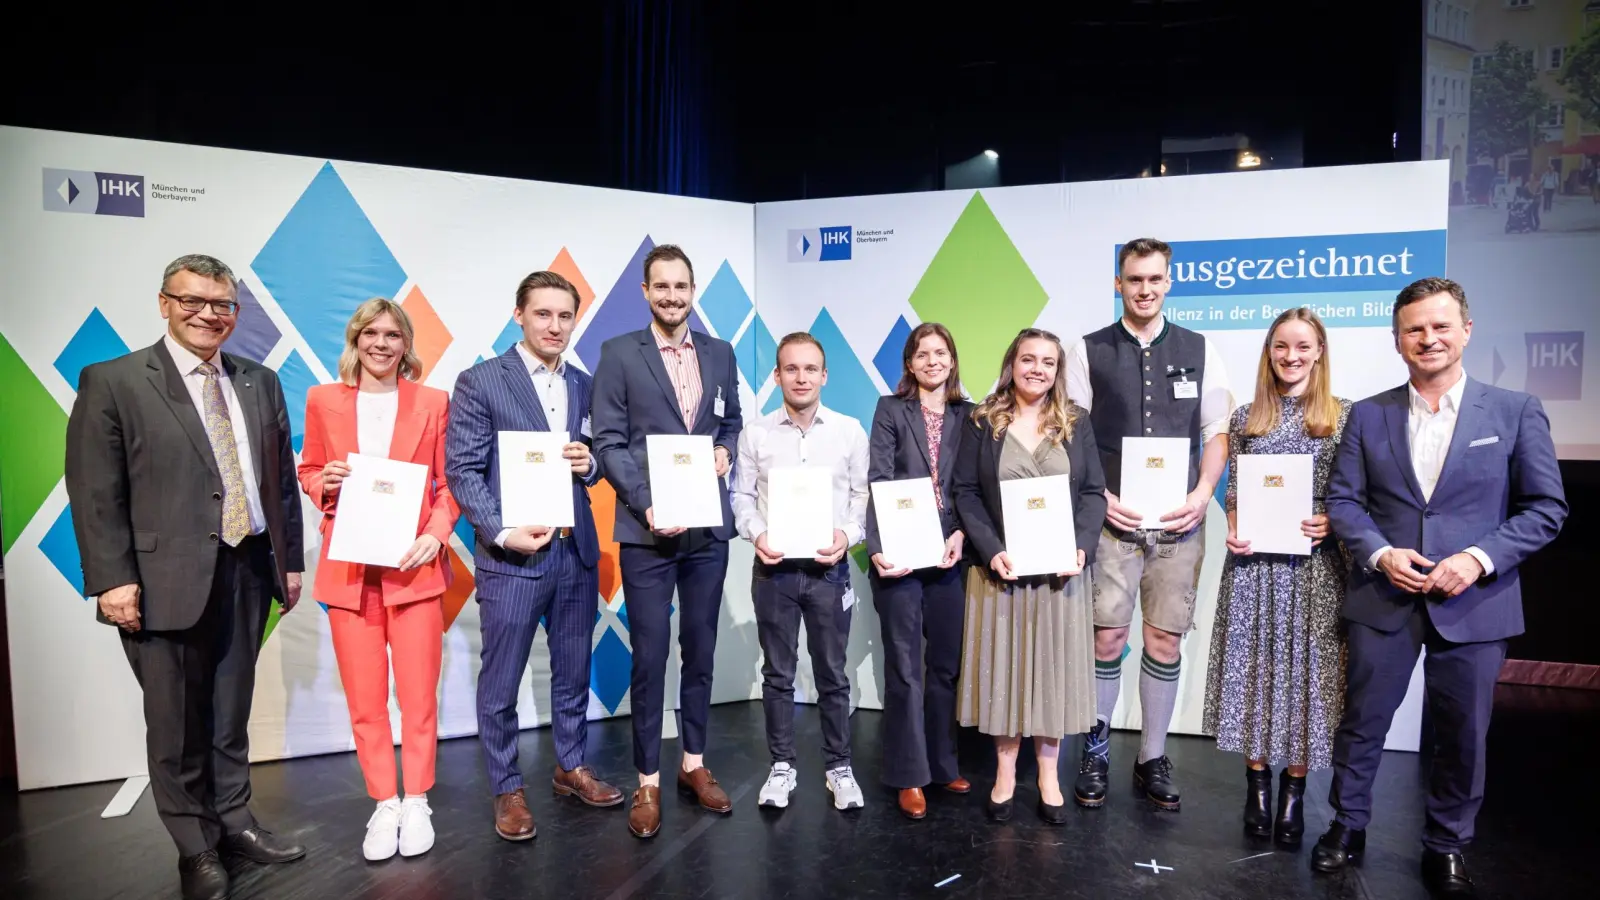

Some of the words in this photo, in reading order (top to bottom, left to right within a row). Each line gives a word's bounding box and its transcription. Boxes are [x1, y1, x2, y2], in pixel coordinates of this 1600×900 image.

[101, 179, 141, 197] IHK
[151, 183, 188, 193] München
[151, 191, 197, 202] Oberbayern
[823, 231, 850, 245] IHK
[856, 229, 881, 237] München
[856, 236, 888, 244] Oberbayern
[1171, 247, 1414, 289] usgezeichnet
[1161, 307, 1204, 321] llenz
[1209, 306, 1224, 321] in
[1229, 305, 1257, 320] der
[1262, 303, 1357, 320] Beichen
[1362, 301, 1394, 318] Bild
[1531, 342, 1579, 368] IHK
